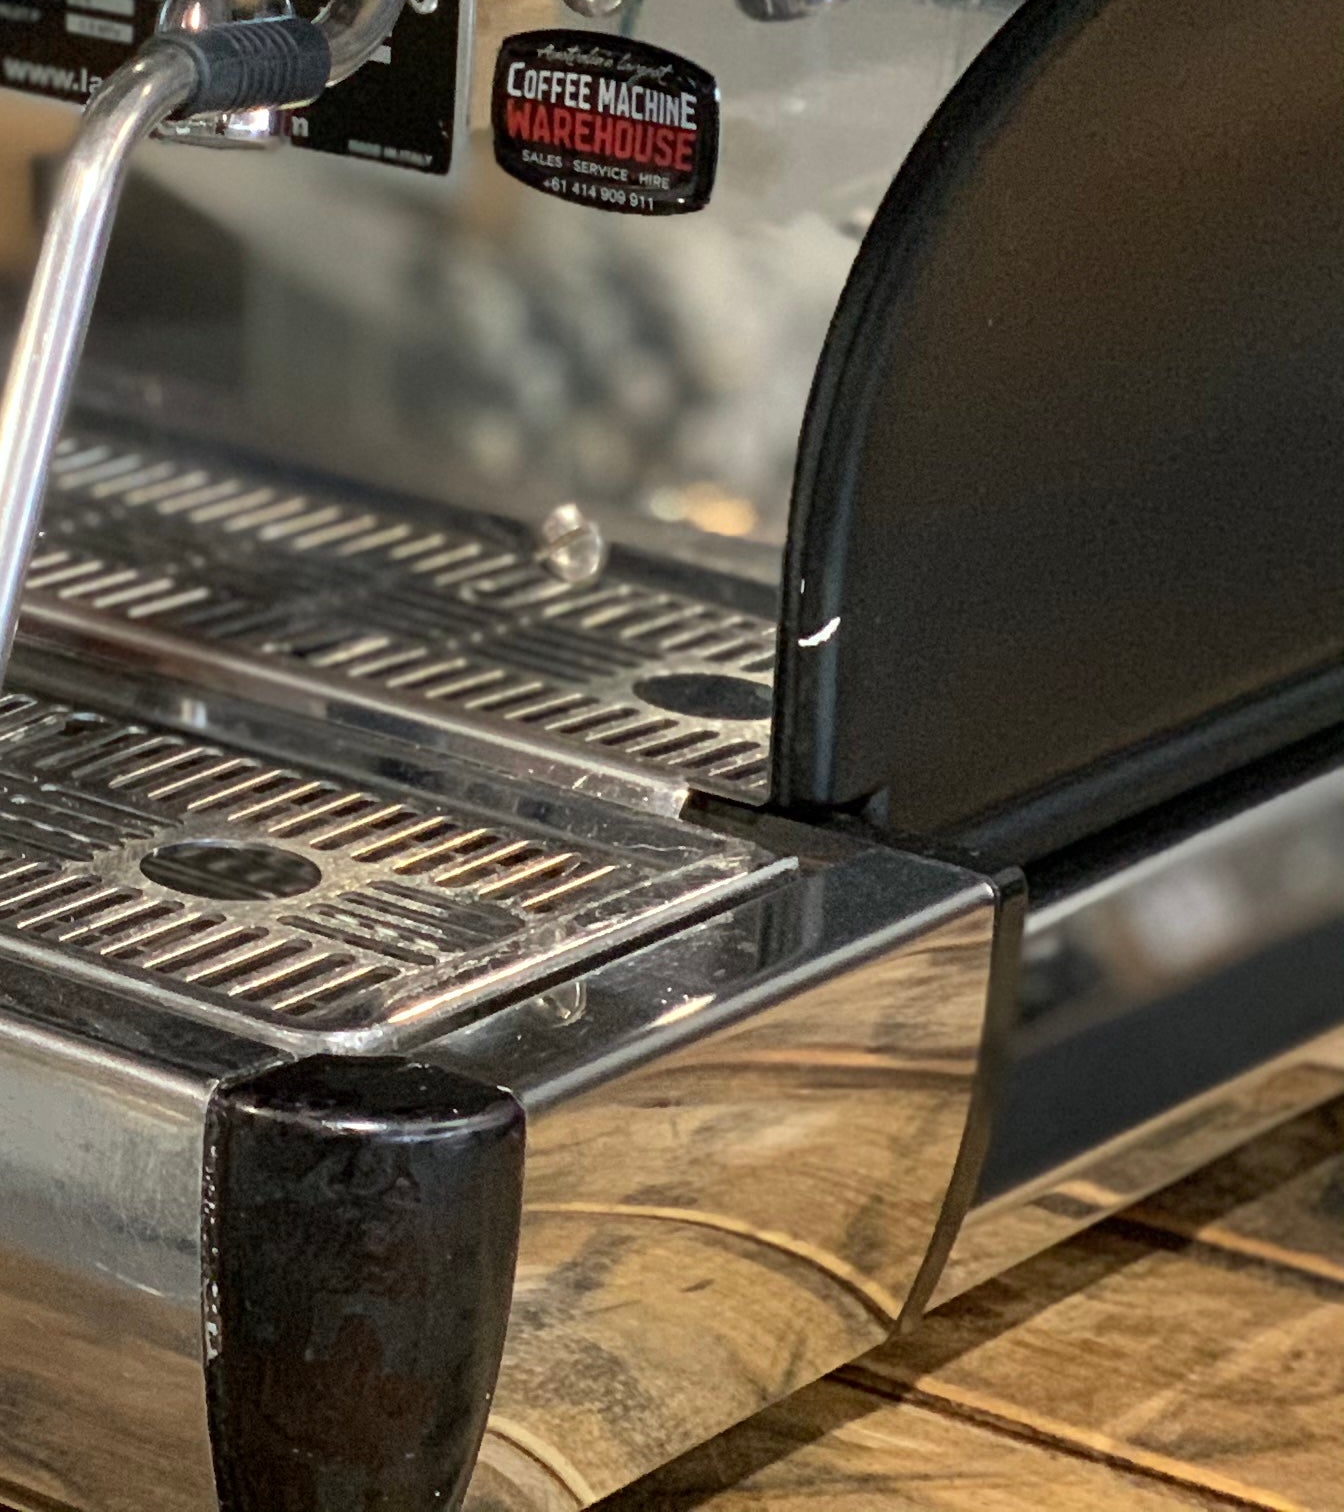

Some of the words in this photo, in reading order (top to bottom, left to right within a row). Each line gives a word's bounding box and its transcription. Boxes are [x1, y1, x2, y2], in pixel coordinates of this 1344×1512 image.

[506, 61, 592, 111] COFFEE
[597, 76, 698, 131] MACHINE
[505, 98, 697, 172] WAREHOUSE
[521, 148, 563, 170] SALES
[572, 158, 629, 183] SERVICE
[638, 172, 671, 190] HIRE
[571, 180, 597, 199] 414
[600, 186, 626, 205] 909
[629, 191, 655, 211] 911
